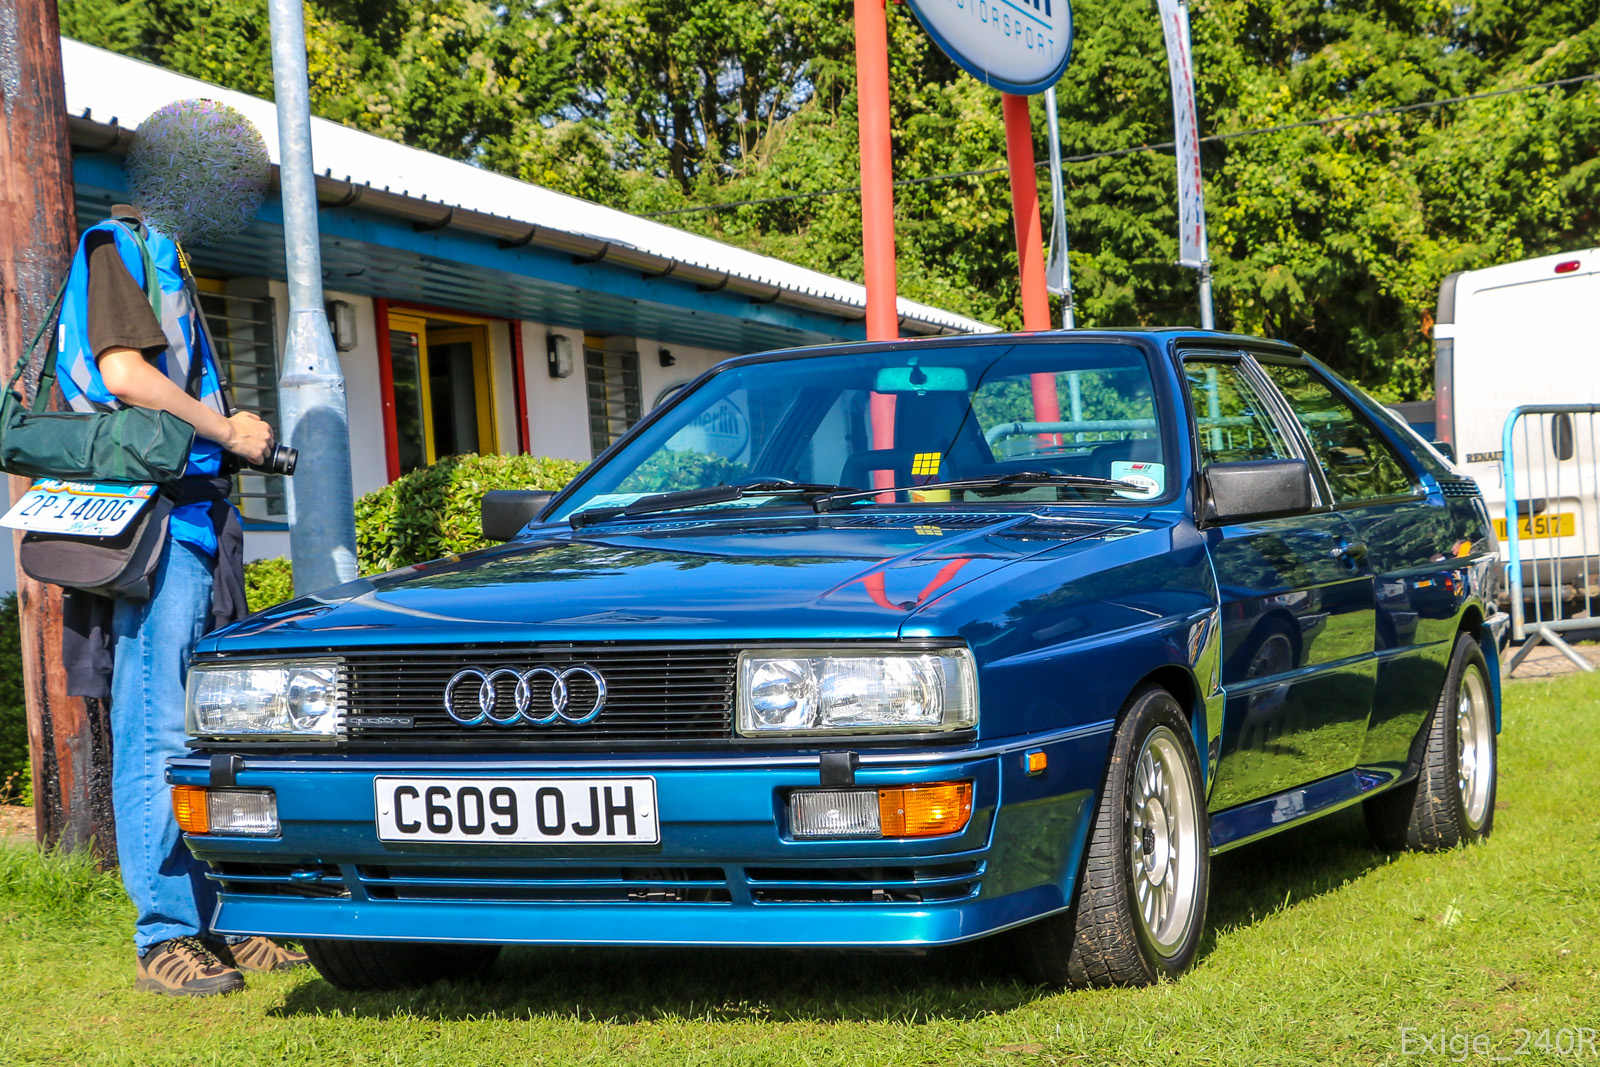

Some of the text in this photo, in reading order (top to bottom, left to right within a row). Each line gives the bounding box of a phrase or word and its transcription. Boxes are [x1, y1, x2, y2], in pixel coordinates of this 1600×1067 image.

[949, 0, 1055, 60] TORSPORT
[349, 717, 410, 726] quattro
[394, 785, 519, 835] C609
